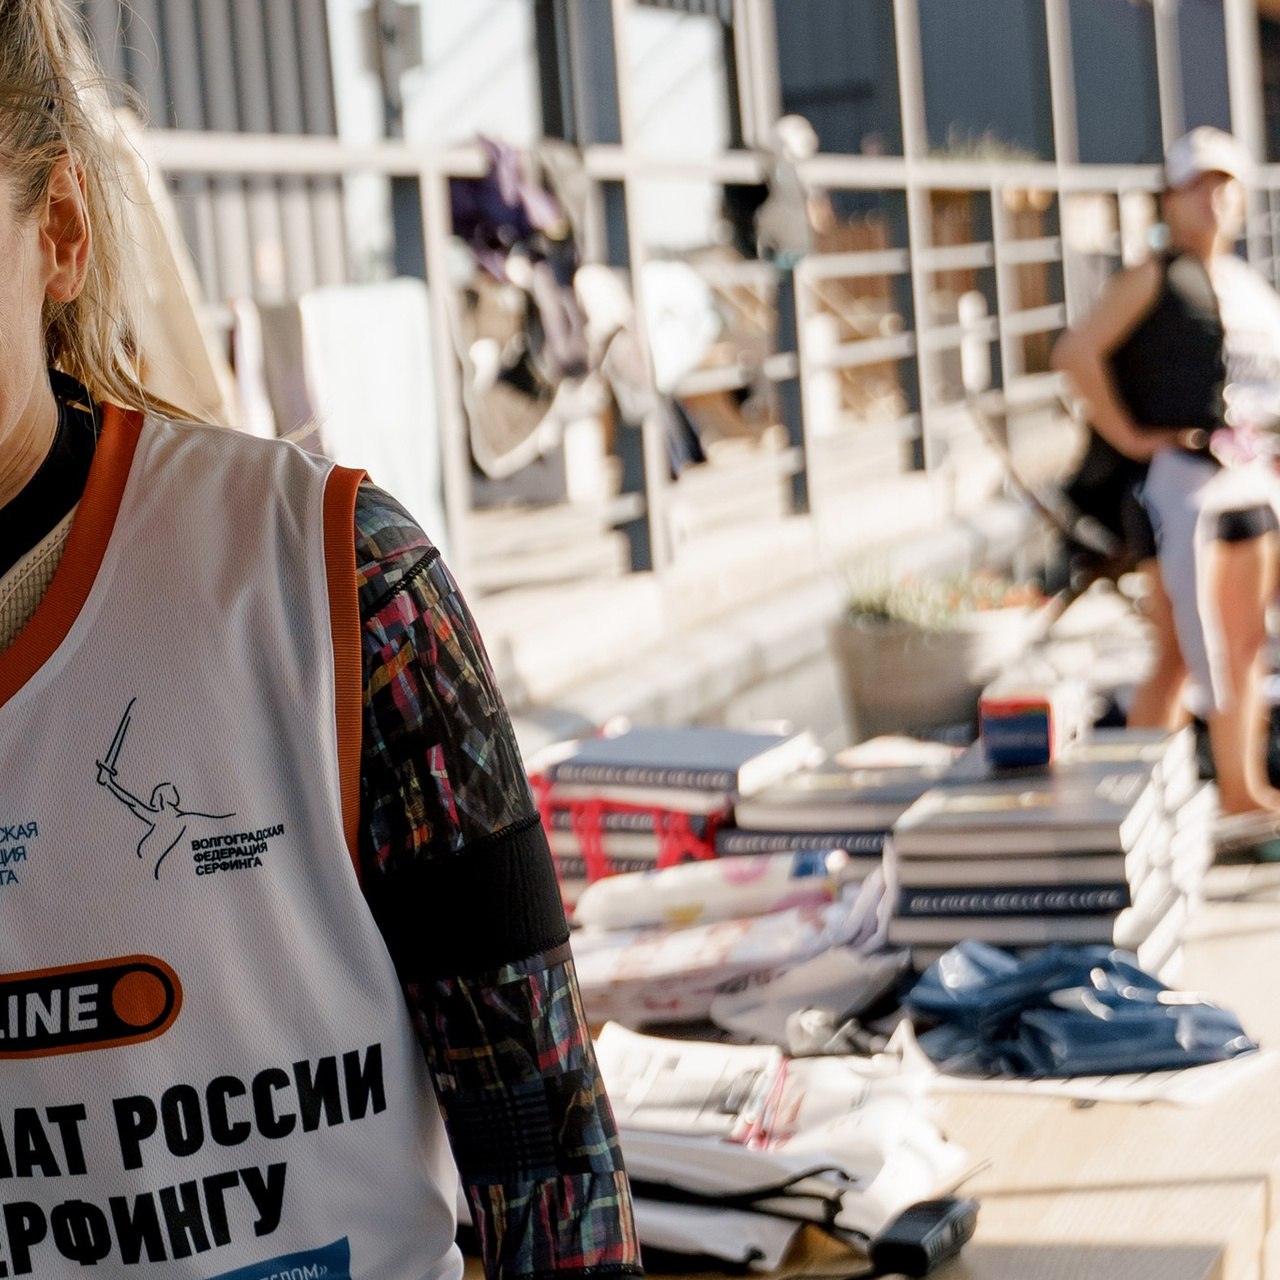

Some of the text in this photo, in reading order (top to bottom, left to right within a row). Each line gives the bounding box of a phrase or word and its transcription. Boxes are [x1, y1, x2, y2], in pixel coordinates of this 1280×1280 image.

[191, 824, 285, 851] ВОЛГОГРАДСКАЯ
[193, 842, 268, 863] ФЕДЕРАЦИЯ
[195, 857, 263, 876] СЕРФИНГА
[112, 1043, 387, 1171] РОССИИ
